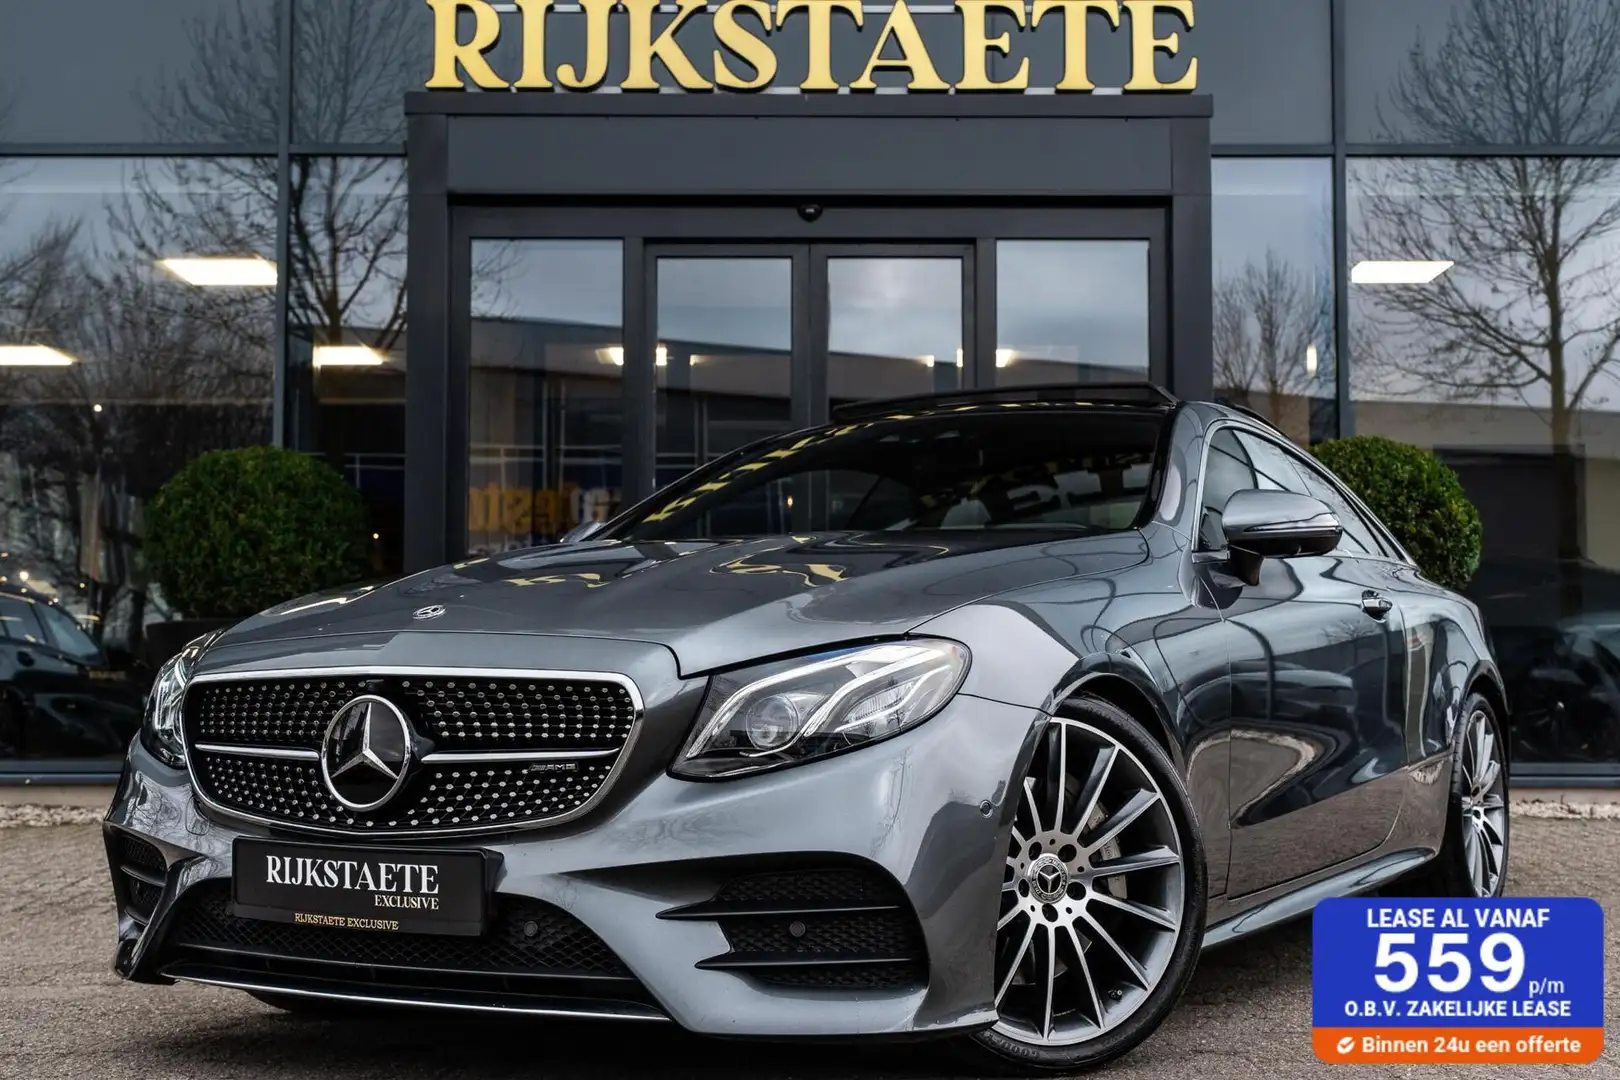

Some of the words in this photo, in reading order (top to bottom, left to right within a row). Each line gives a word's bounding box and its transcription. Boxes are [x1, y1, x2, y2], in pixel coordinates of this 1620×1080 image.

[425, 0, 1198, 91] RIJKSTAETE
[266, 855, 439, 894] RIJKSTAETE
[374, 894, 439, 910] EXCLUSIVE
[294, 912, 346, 927] RIJKSTAETE
[347, 917, 399, 931] EXCLUSIVE
